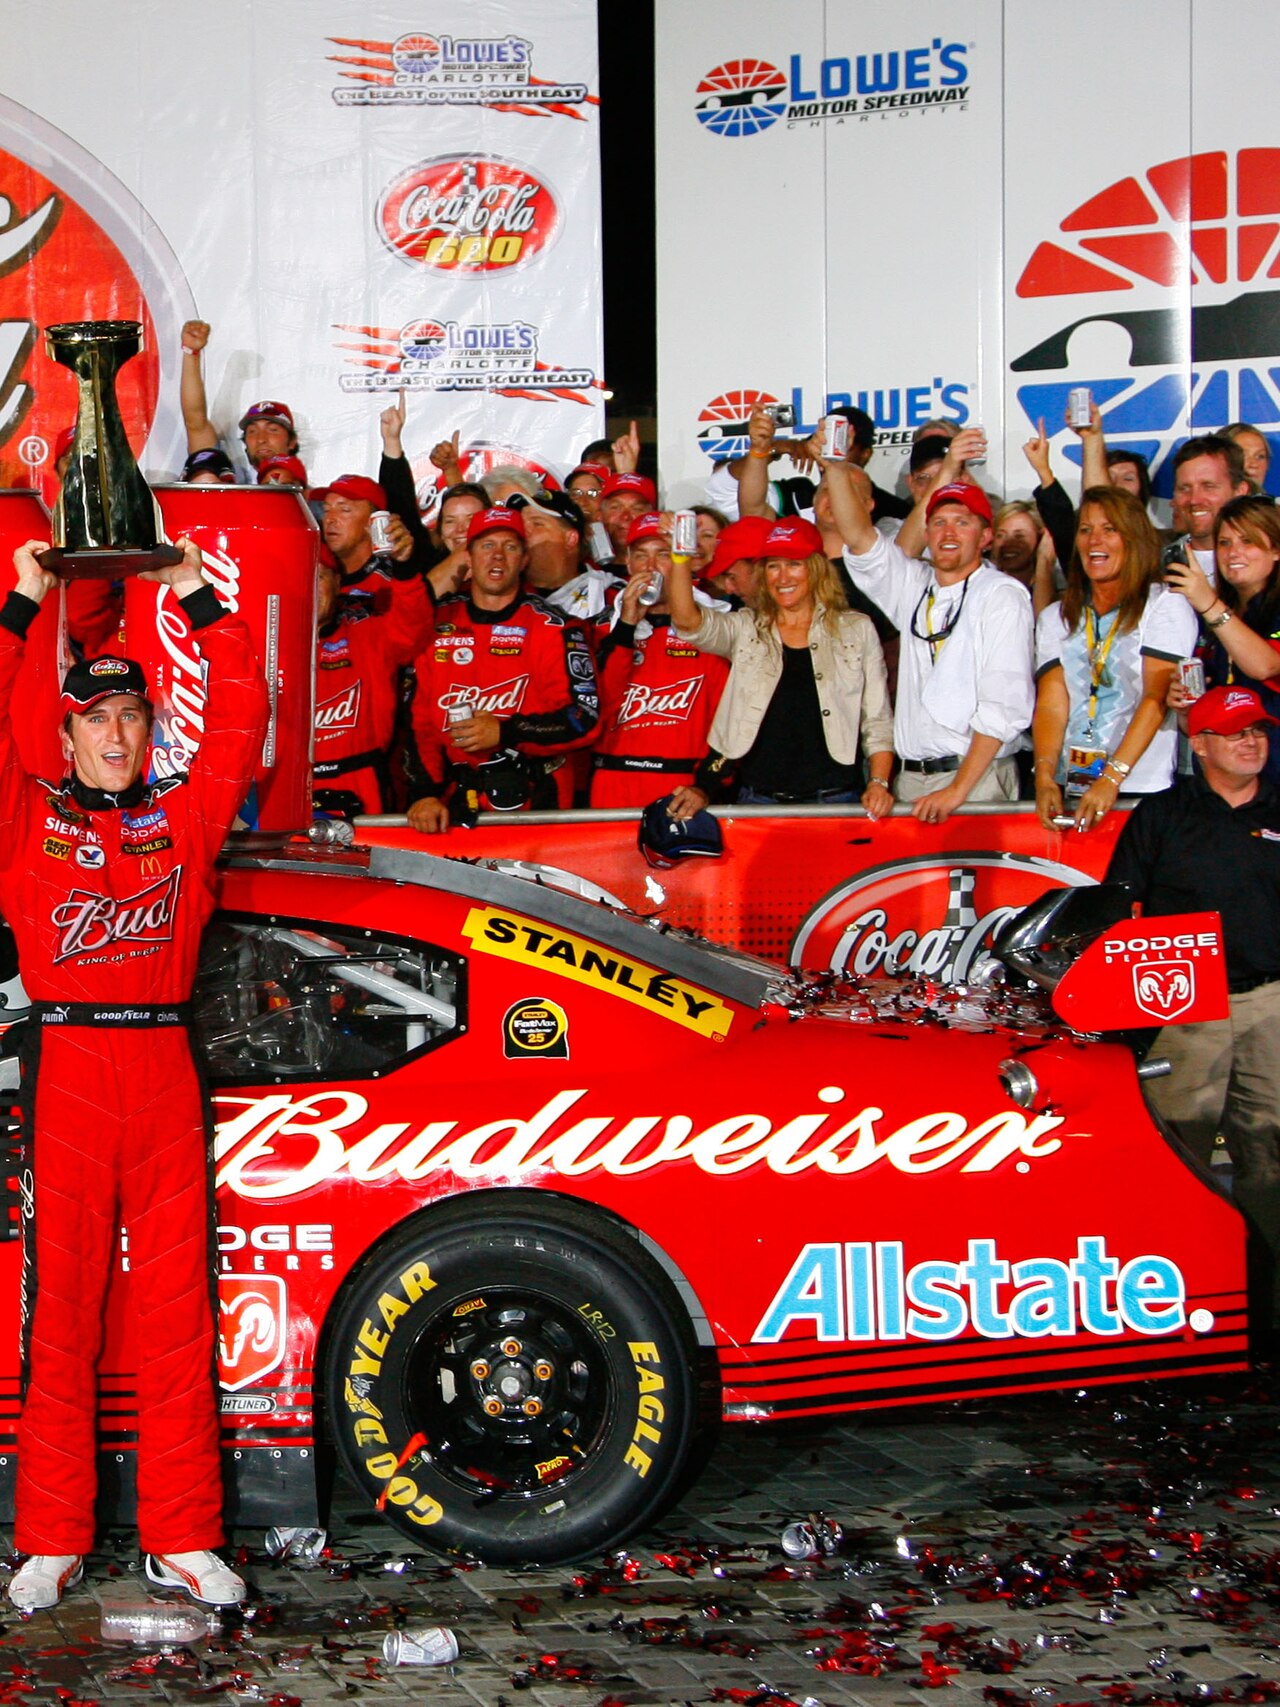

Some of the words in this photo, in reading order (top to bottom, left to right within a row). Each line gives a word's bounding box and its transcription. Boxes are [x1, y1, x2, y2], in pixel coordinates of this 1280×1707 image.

[442, 39, 527, 63] LOWE'S
[396, 73, 526, 83] CHARLOTTE
[790, 38, 969, 102] LOWE'S
[480, 88, 585, 99] SOUTHEAST
[787, 96, 858, 119] MOTOR
[863, 86, 970, 111] SPEEDWAY
[786, 103, 969, 130] CHARLOTTE
[399, 183, 540, 234] Coca-Cola
[424, 235, 524, 264] 600
[449, 323, 532, 349] LOWE'S
[403, 358, 532, 369] CHARLOTTE
[315, 688, 355, 727] ud
[438, 678, 524, 712] Bud
[619, 681, 696, 723] Bud
[124, 838, 169, 853] STANLEY
[51, 886, 170, 954] Bud
[1104, 932, 1218, 954] DODGE
[1105, 947, 1219, 964] DEALERS
[77, 955, 108, 966] KING
[483, 916, 716, 1020] STANLEY
[94, 1009, 151, 1021] GOODYEAR
[513, 1019, 557, 1028] FatMax
[527, 1033, 546, 1043] 25
[211, 1086, 1066, 1199] Budweiser
[751, 1236, 1186, 1343] Allstate
[344, 1261, 444, 1526] GOODYEAR
[623, 1341, 666, 1479] EAGLE
[540, 1459, 564, 1474] AERO
